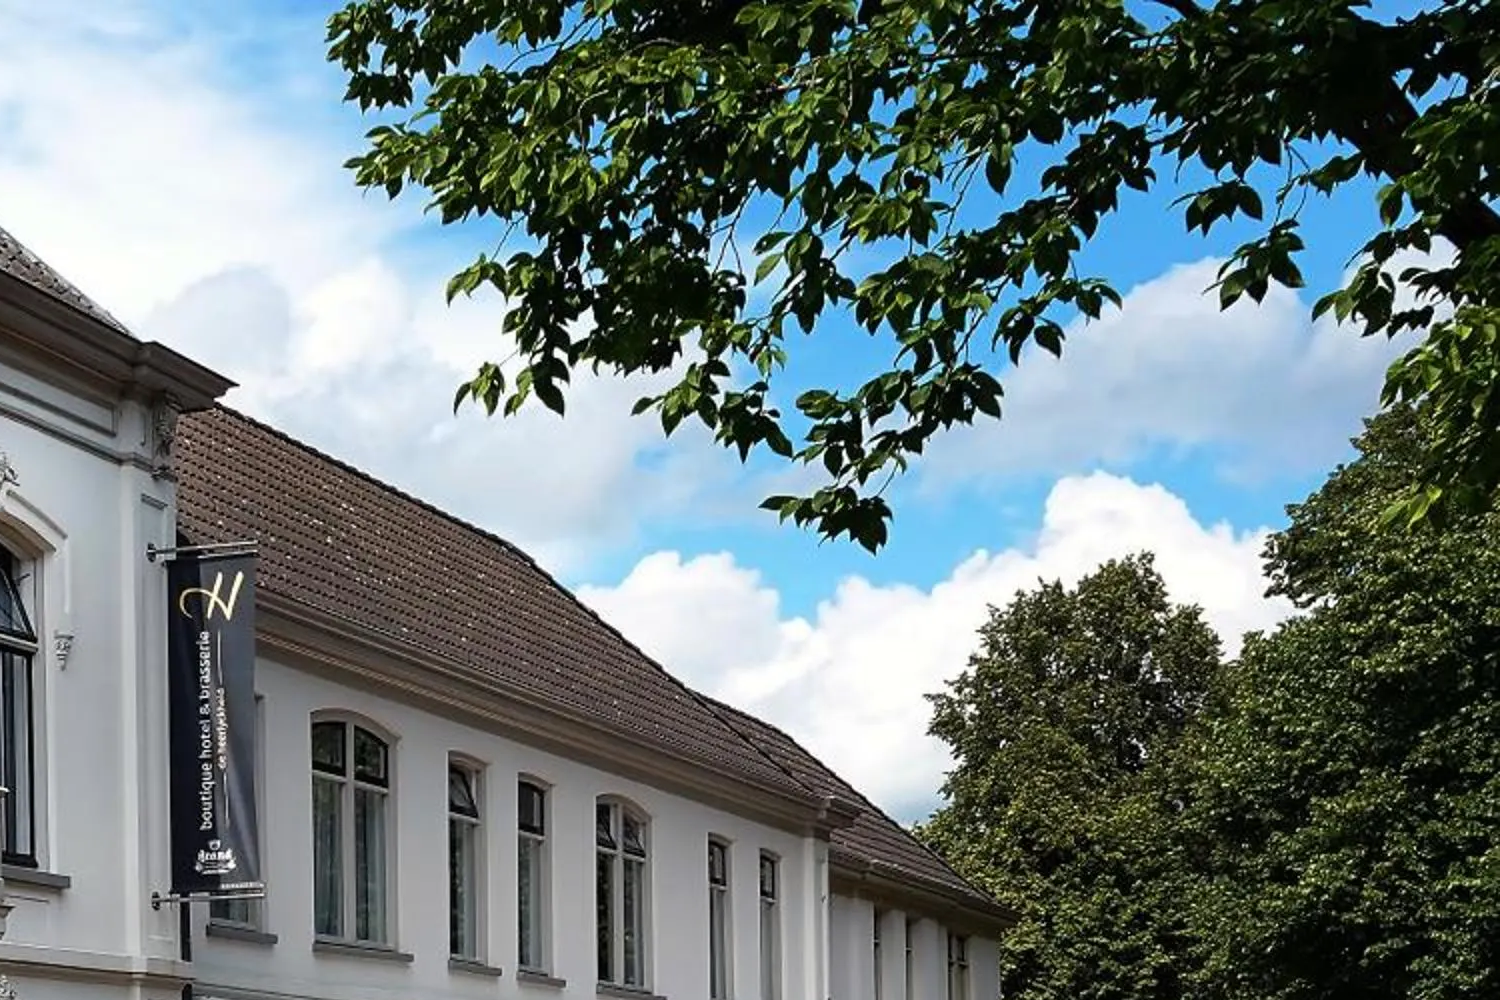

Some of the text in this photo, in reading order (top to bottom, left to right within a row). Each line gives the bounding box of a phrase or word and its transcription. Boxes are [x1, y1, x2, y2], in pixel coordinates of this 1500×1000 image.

[199, 703, 211, 715] &
[198, 720, 212, 759] hotel
[199, 763, 216, 831] boutique
